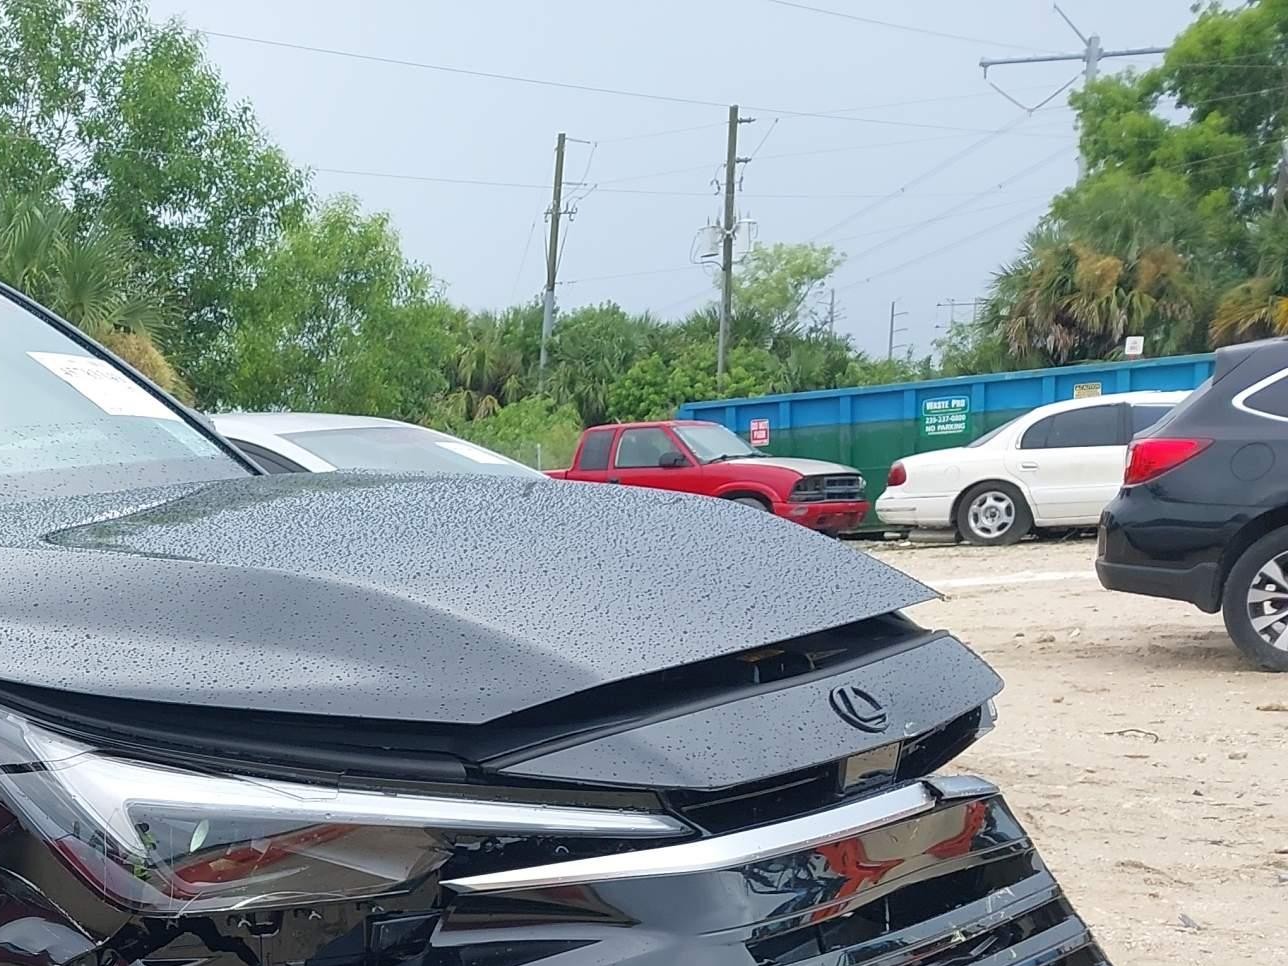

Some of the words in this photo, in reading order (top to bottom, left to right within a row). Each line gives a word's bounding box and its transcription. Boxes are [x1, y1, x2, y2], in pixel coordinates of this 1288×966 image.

[926, 400, 949, 410] WASTE
[952, 398, 966, 408] PRO
[925, 424, 935, 432] NO
[937, 422, 966, 431] PARKING
